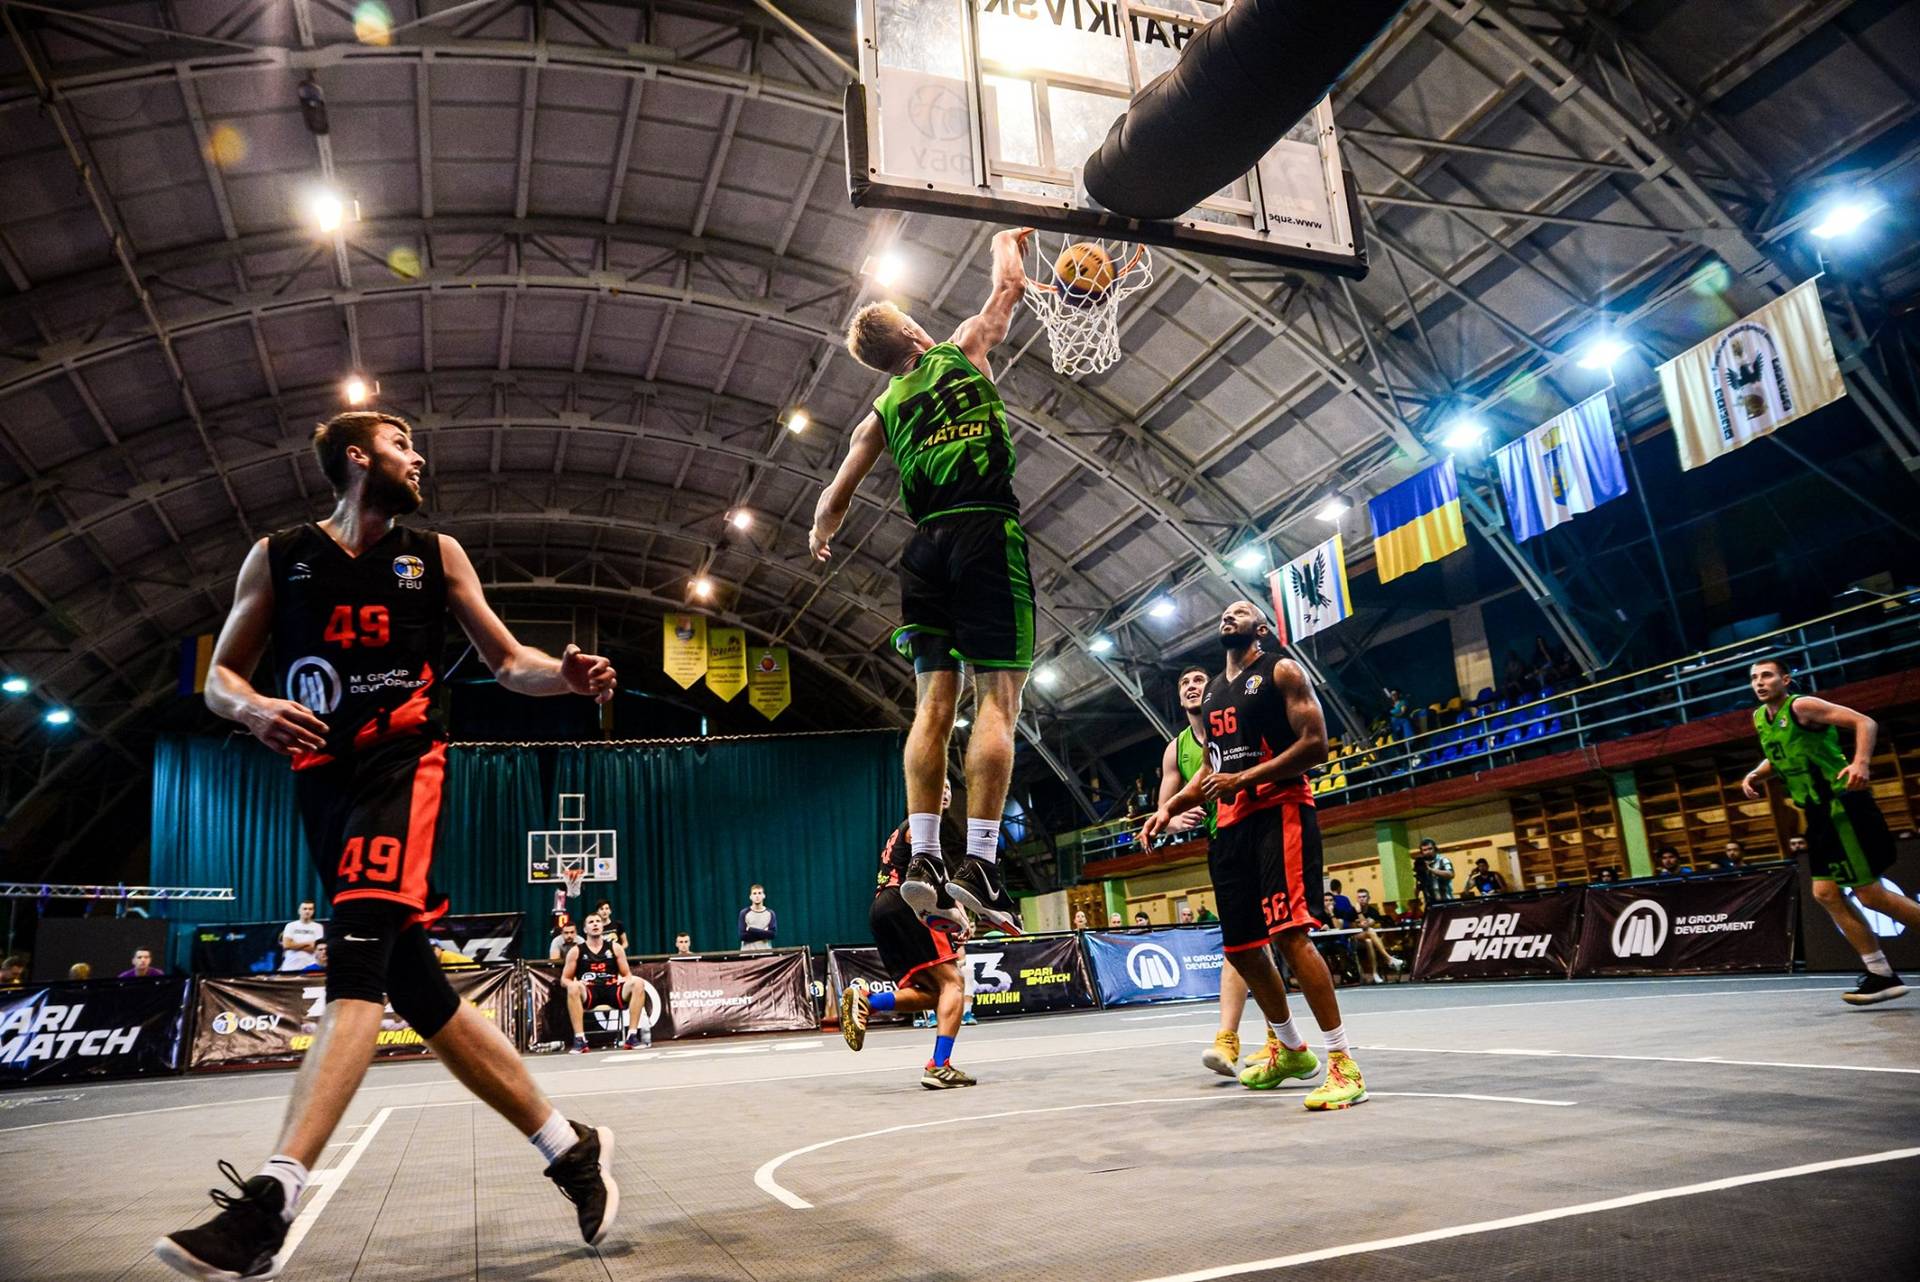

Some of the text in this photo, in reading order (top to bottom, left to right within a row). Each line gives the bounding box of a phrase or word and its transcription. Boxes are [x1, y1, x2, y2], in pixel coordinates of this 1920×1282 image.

[398, 579, 422, 590] FBU
[324, 604, 390, 649] 49
[350, 675, 361, 683] M
[1209, 705, 1237, 737] 56
[338, 835, 402, 883] 49
[1261, 892, 1289, 927] 56
[1443, 912, 1520, 940] PARI
[1676, 913, 1728, 925] M GROUP
[1674, 920, 1755, 935] DEVELOPMENT
[1447, 934, 1552, 962] MATCH
[1192, 953, 1224, 962] GROUP
[1020, 967, 1053, 979] PARI
[1026, 973, 1070, 986] MATCH
[669, 989, 724, 999] M GROUP
[976, 990, 1020, 1006] УКРАЇНИ
[670, 996, 753, 1009] DEVELOPMENT
[0, 1003, 85, 1036] ARI
[238, 1014, 281, 1031] ФБУ
[376, 1027, 424, 1045] КРАЇН
